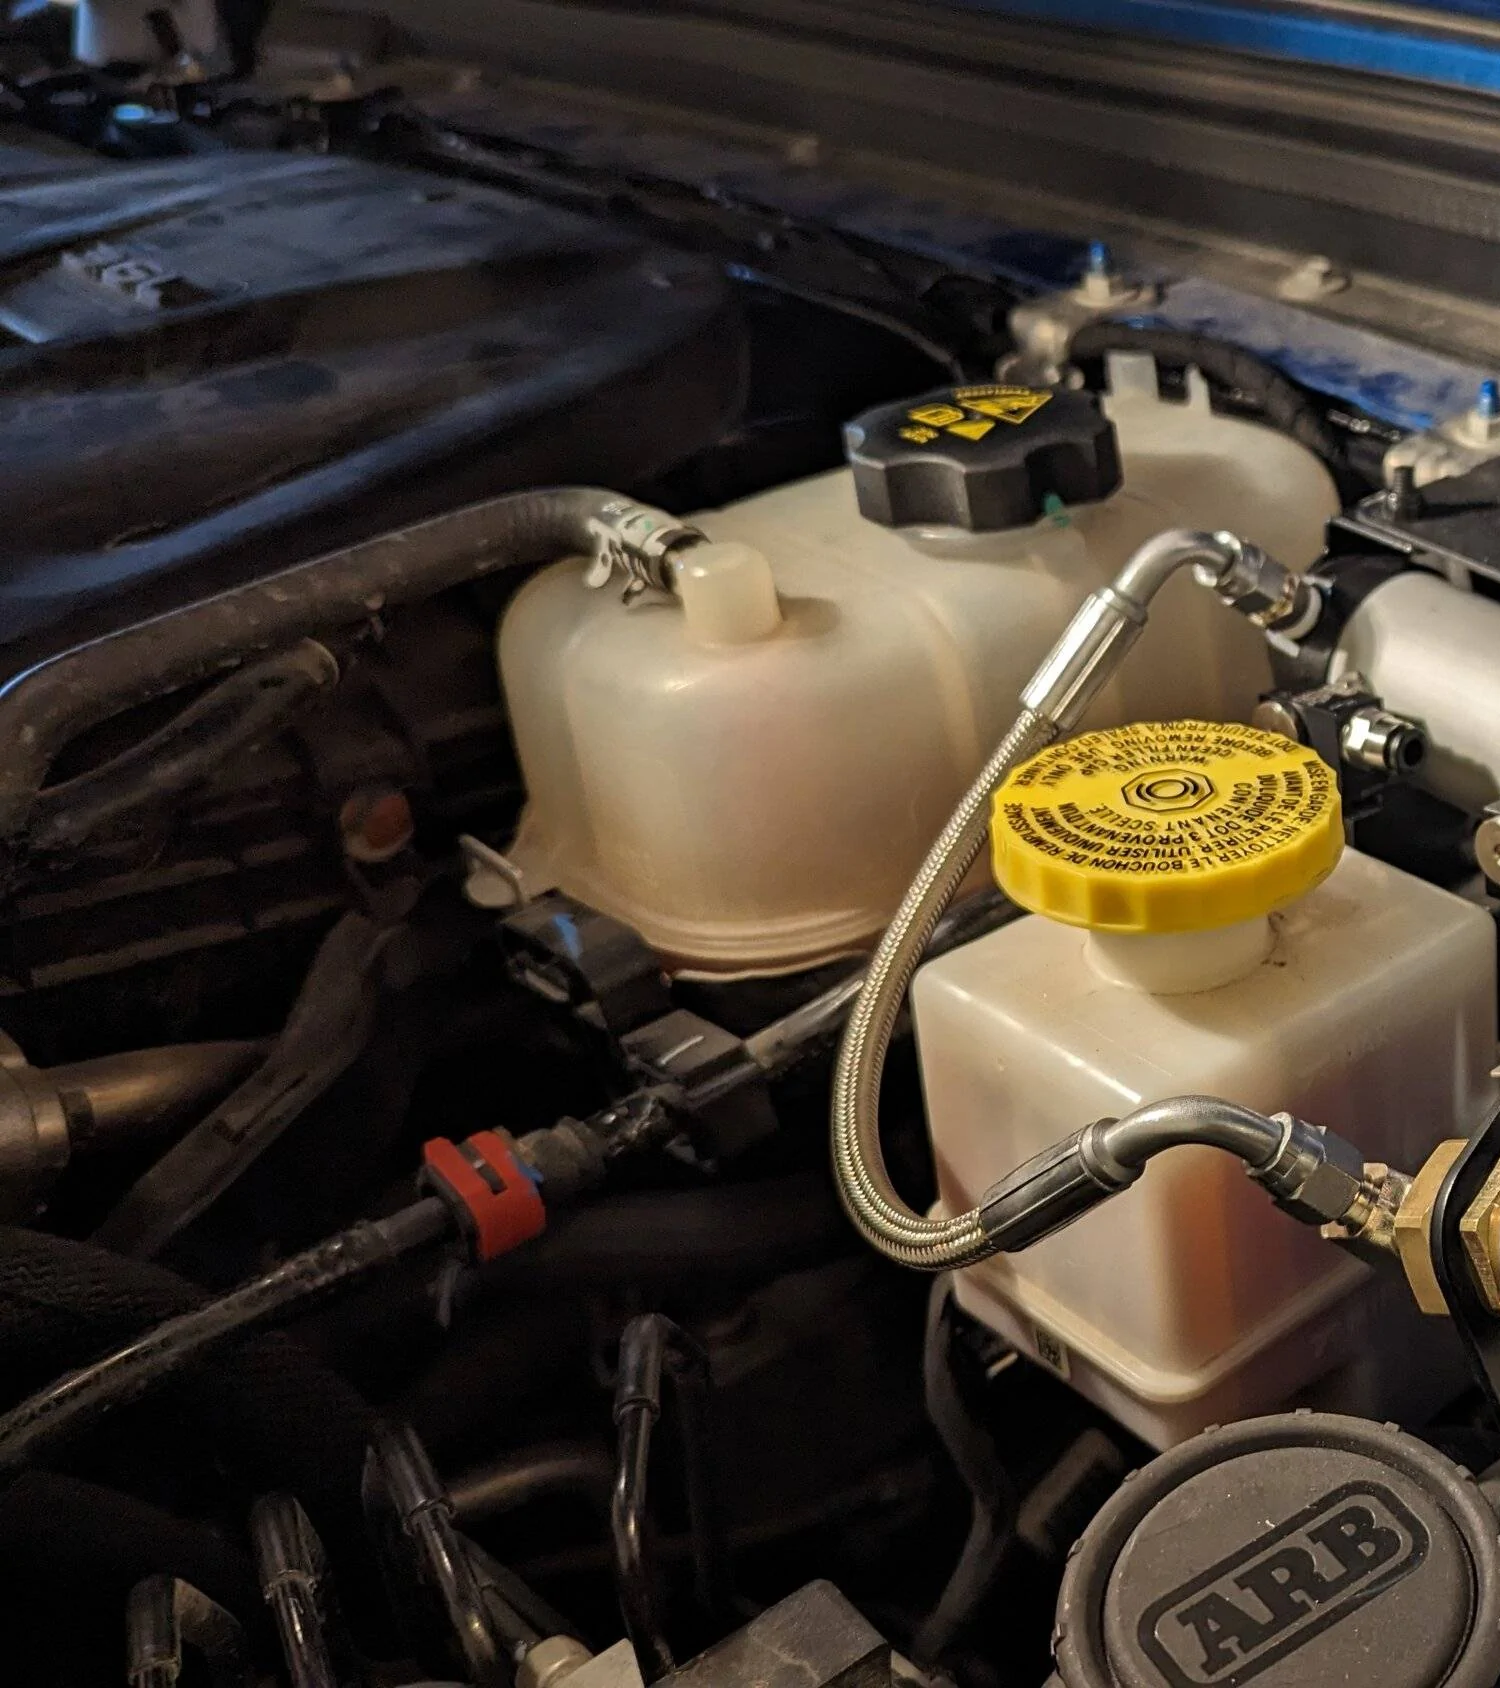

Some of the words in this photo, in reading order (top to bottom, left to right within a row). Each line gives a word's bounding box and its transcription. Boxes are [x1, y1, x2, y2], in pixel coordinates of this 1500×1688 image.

[1161, 722, 1209, 731] FROM
[1212, 725, 1258, 739] FLUID
[1079, 727, 1140, 746] SEALED
[1110, 745, 1170, 760] FILLER
[1176, 744, 1232, 757] CLEAN
[1211, 736, 1274, 757] BEFORE
[1266, 738, 1299, 752] DOT
[1069, 747, 1104, 763] USE
[1039, 764, 1072, 786] ONLY
[1080, 759, 1109, 775] CAP
[1302, 760, 1328, 779] MISE
[1257, 774, 1277, 786] DU
[1281, 771, 1303, 797] AVANT
[1310, 780, 1329, 791] EN
[1166, 783, 1252, 831] CONTENANT
[1237, 788, 1277, 823] LIQUIDE
[1277, 799, 1300, 811] DE
[1264, 811, 1289, 824] LE
[1003, 803, 1065, 856] REMPLISSAGE
[1031, 807, 1105, 852] UNIQUEMENT
[1073, 821, 1184, 845] PROVENANT
[1189, 832, 1200, 841] 3
[1206, 821, 1241, 839] DOT
[1106, 846, 1191, 858] UTILISER
[1216, 826, 1300, 862] NETTOYER
[1062, 851, 1089, 864] DE
[1089, 857, 1183, 871] BOUCHON
[1188, 857, 1213, 868] LE
[1176, 1505, 1401, 1676] ARB
